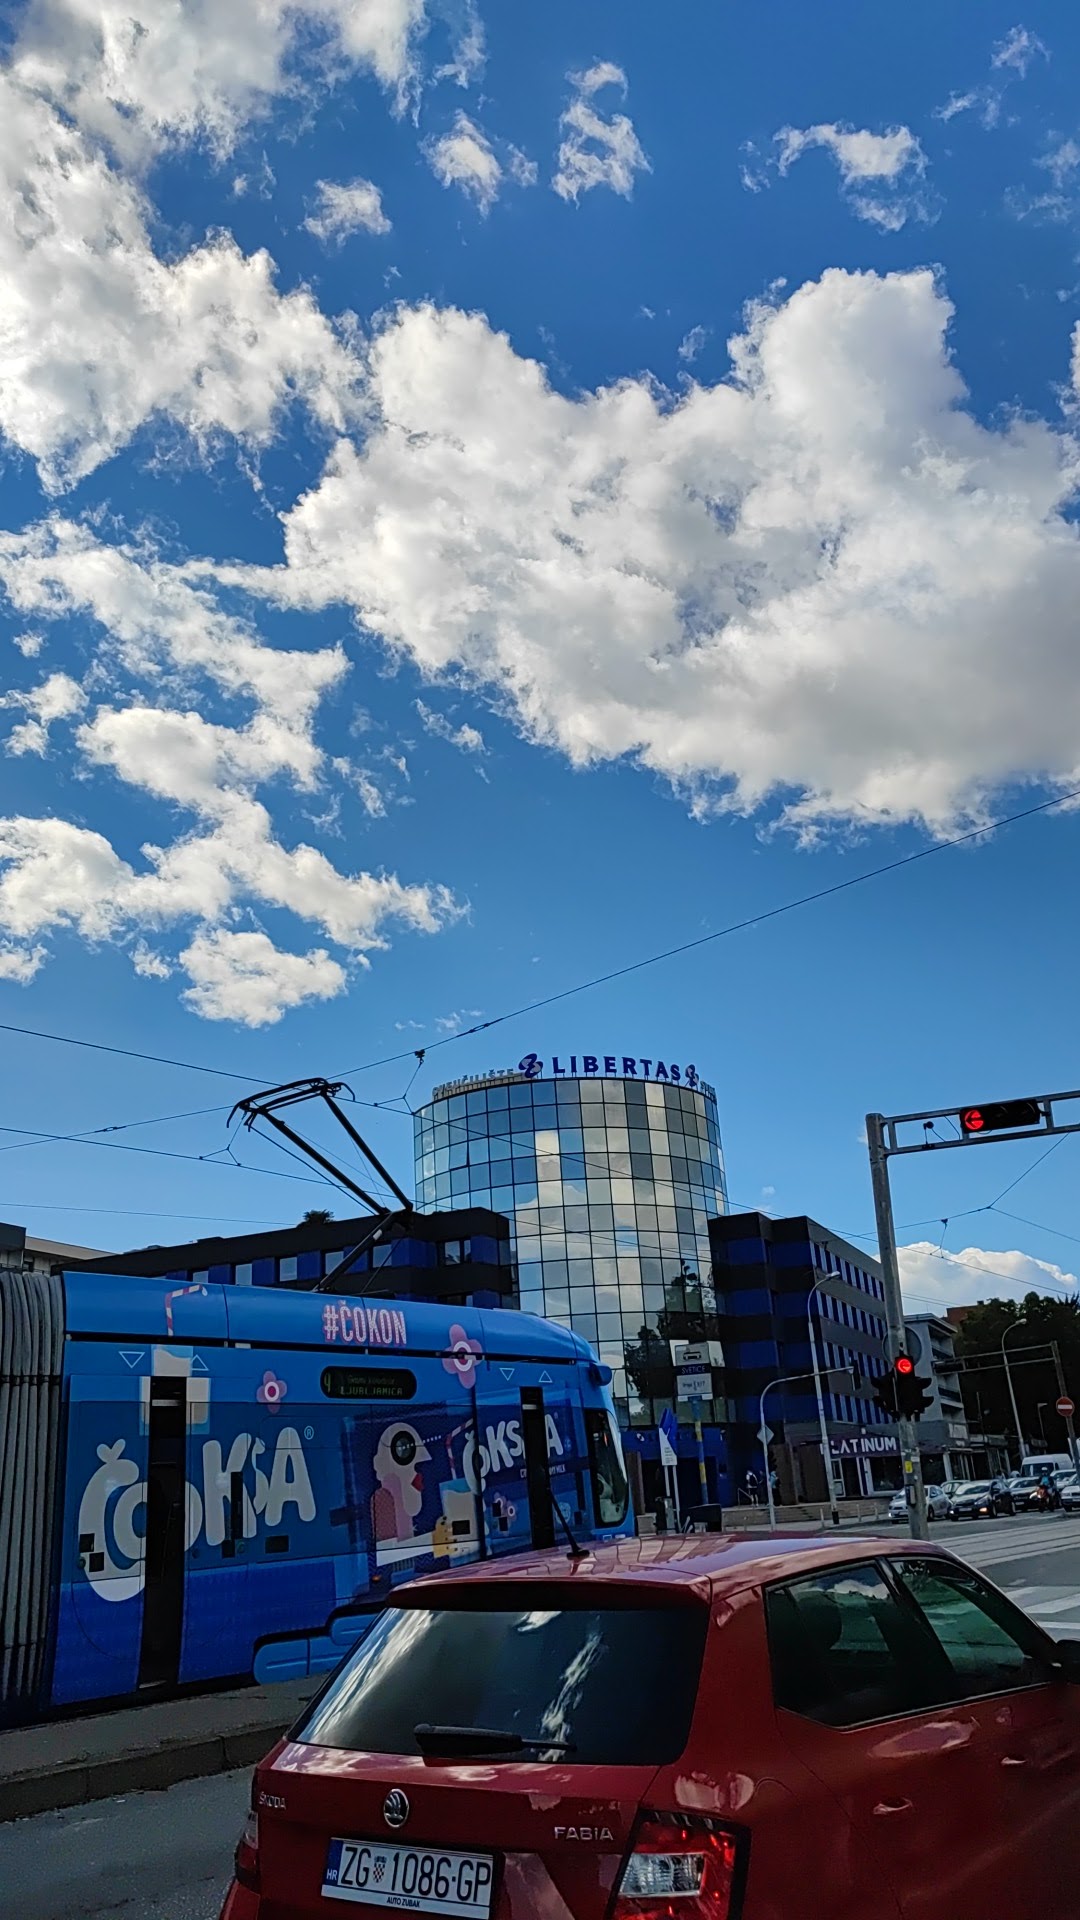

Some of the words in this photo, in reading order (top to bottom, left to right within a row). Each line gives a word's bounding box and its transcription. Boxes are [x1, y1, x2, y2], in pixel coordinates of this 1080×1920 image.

[551, 1055, 682, 1081] LIBERTAS
[322, 1299, 408, 1346] #ČOKON
[681, 1364, 707, 1376] SVETICE
[820, 1436, 897, 1456] LATINUM
[553, 1826, 614, 1841] FABIA
[326, 1869, 338, 1881] HR
[340, 1846, 372, 1888] ZG
[386, 1897, 401, 1906] AUTO
[401, 1899, 421, 1909] ZUBAK
